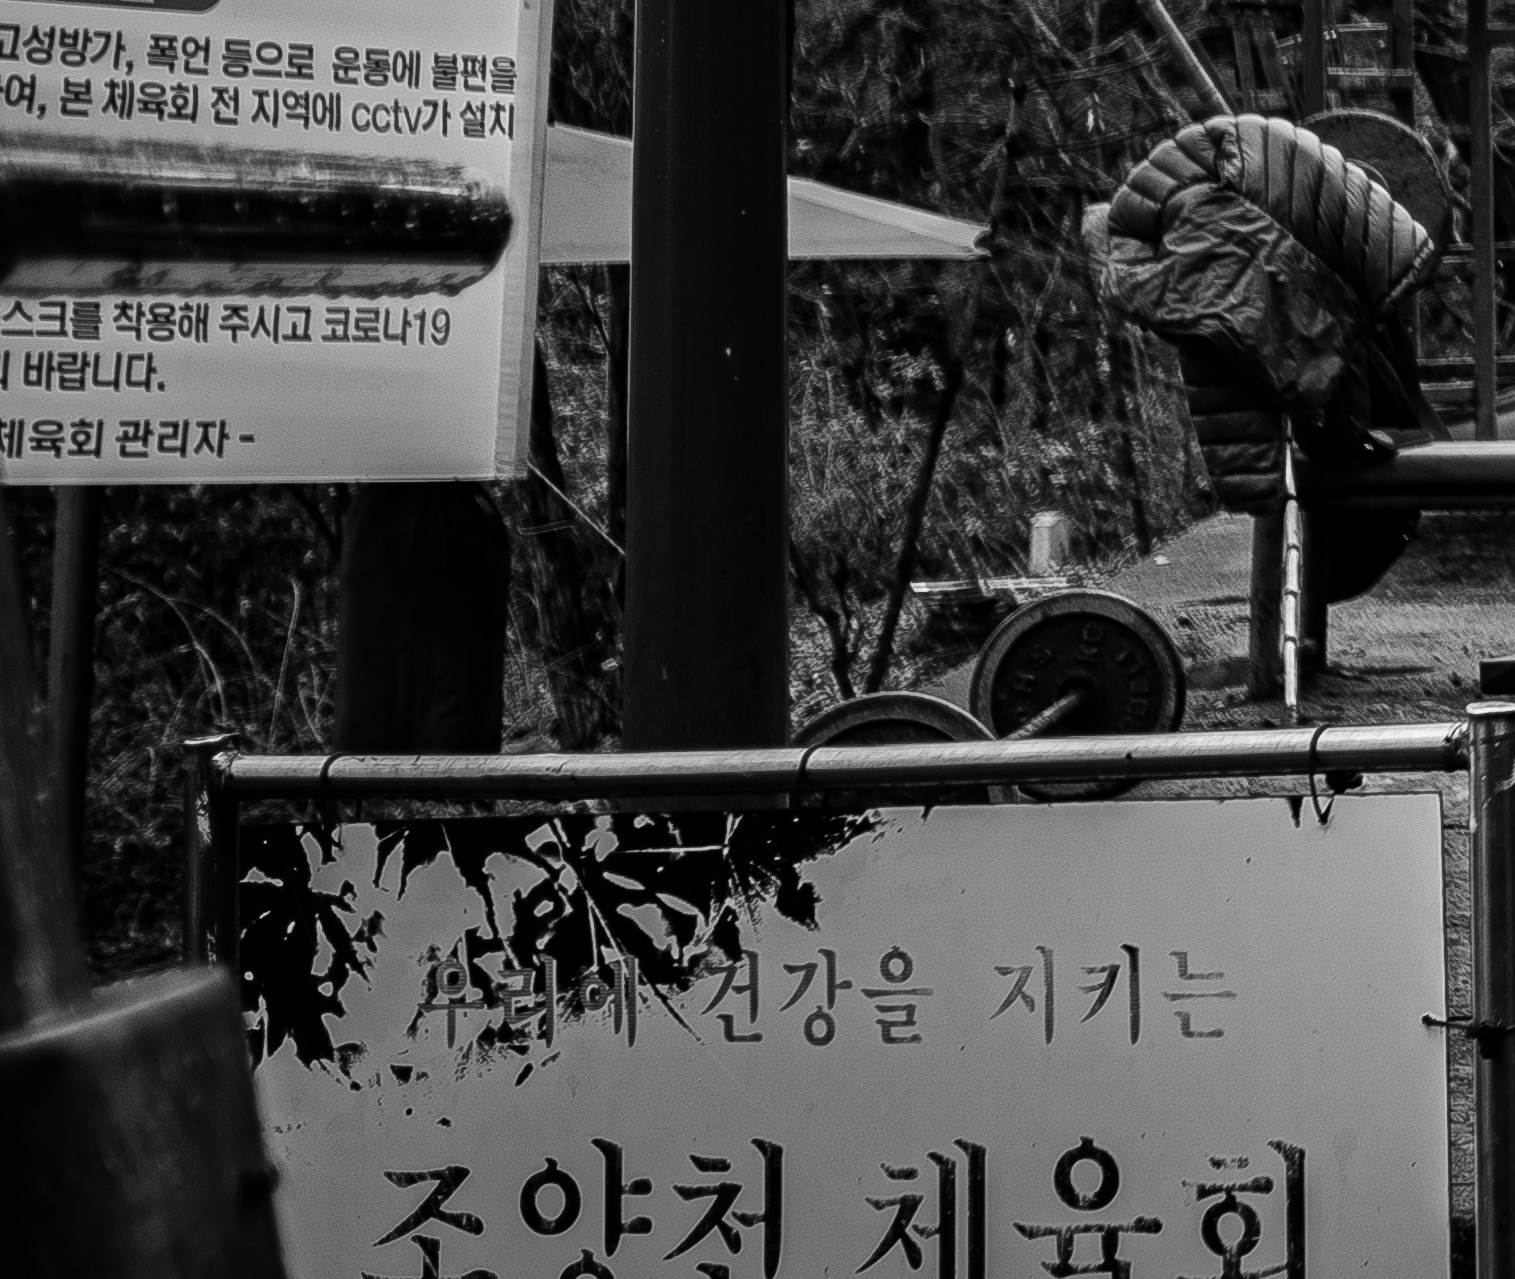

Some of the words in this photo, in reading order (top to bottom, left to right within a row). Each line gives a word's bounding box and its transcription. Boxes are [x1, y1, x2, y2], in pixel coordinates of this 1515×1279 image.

[0, 23, 134, 77] 고성방가,
[147, 34, 211, 76] 폭언
[222, 38, 314, 80] 등으로
[332, 46, 421, 89] 운동에
[431, 52, 518, 95] 불편을
[59, 77, 93, 118] 본
[101, 78, 199, 123] 체육회
[210, 86, 240, 126] 전
[251, 88, 342, 131] 지역에
[352, 98, 452, 137] cctv가
[460, 100, 515, 141] 설치
[1, 299, 102, 340] 스크를
[112, 301, 210, 343] 착용해
[218, 304, 312, 344] 주시고
[321, 306, 451, 346] 코로나19
[23, 351, 166, 392] 바랍니다.
[701, 942, 934, 1048] 건강을
[989, 944, 1237, 1047] 지키는
